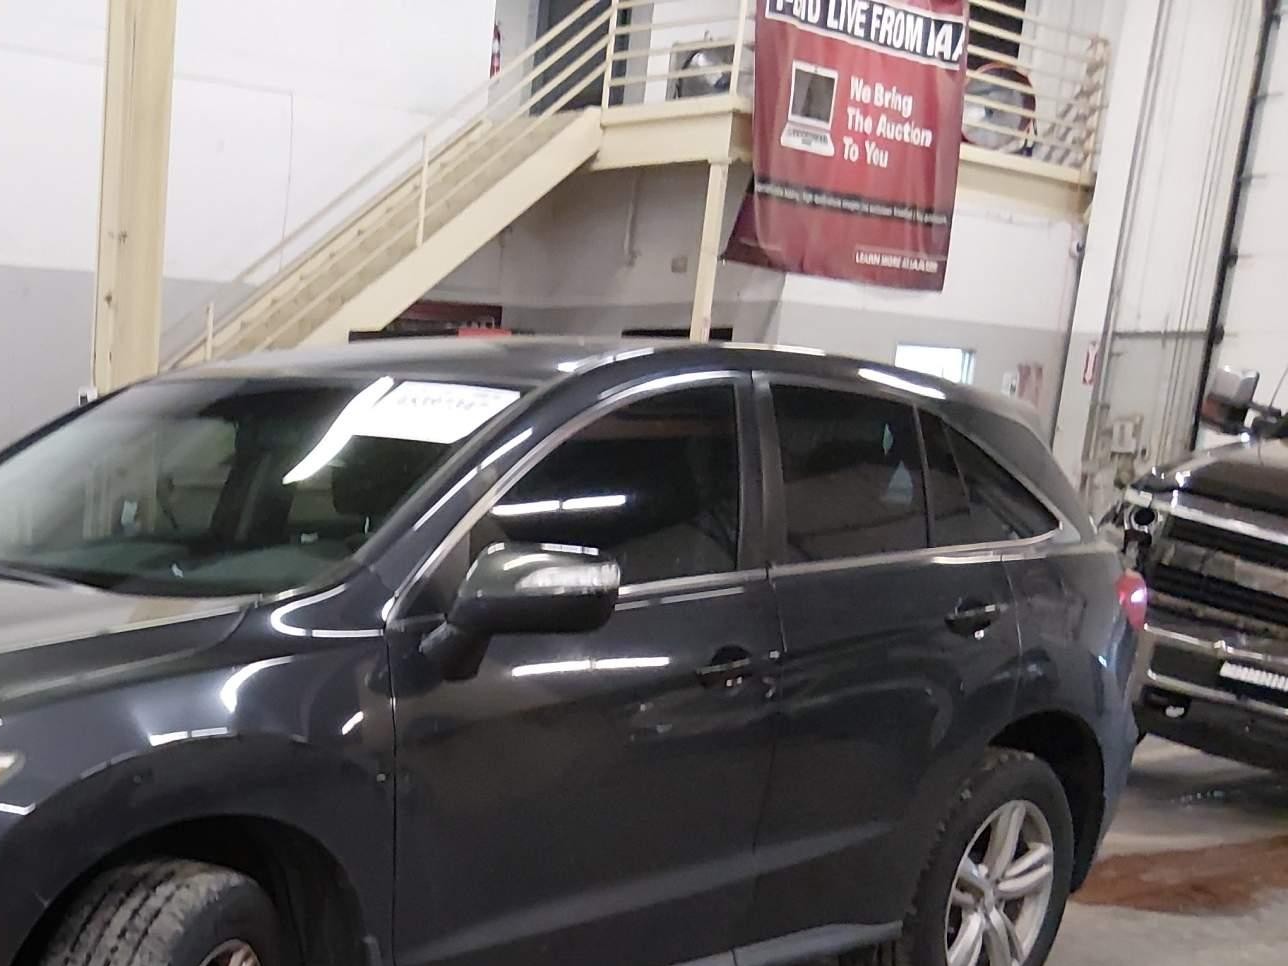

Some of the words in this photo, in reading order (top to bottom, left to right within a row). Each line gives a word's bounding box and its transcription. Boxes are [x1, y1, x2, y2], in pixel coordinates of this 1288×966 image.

[826, 0, 868, 37] LIVE
[870, 4, 924, 52] FROM
[873, 82, 913, 118] Bring
[846, 106, 873, 135] The
[876, 113, 933, 148] Auction
[842, 135, 860, 162] To
[864, 140, 889, 168] You
